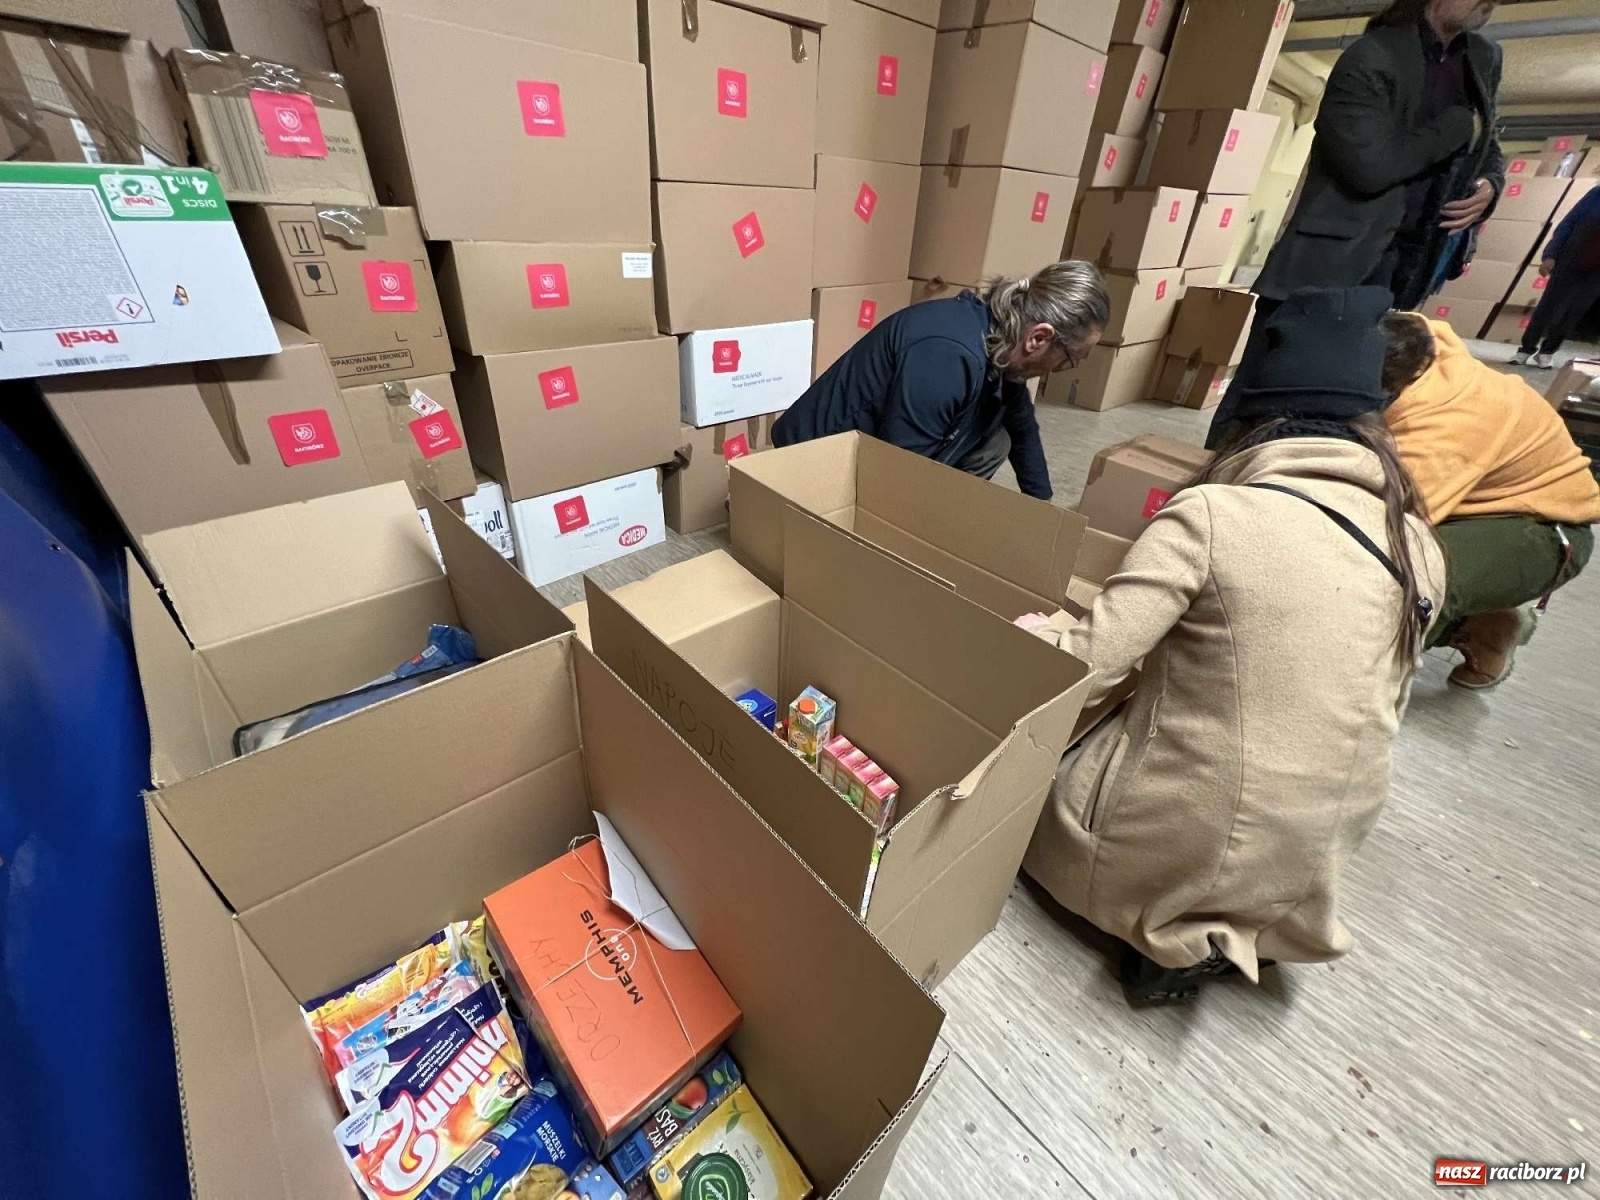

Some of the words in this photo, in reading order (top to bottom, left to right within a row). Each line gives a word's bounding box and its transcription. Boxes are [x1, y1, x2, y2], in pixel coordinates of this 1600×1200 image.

[182, 199, 218, 208] DISCS
[55, 328, 119, 348] Persil
[331, 355, 377, 367] OPAKOWANIE
[355, 363, 391, 373] OVERPACK
[294, 443, 324, 453] RACIBÓRZ
[621, 527, 645, 546] MEDICA
[632, 651, 737, 767] NAPOJE
[580, 908, 643, 1005] MEMPHIS
[609, 935, 631, 962] one
[535, 1125, 560, 1162] MORSKIE
[541, 1120, 567, 1159] MUSZELKI
[647, 1127, 665, 1149] RYŻ
